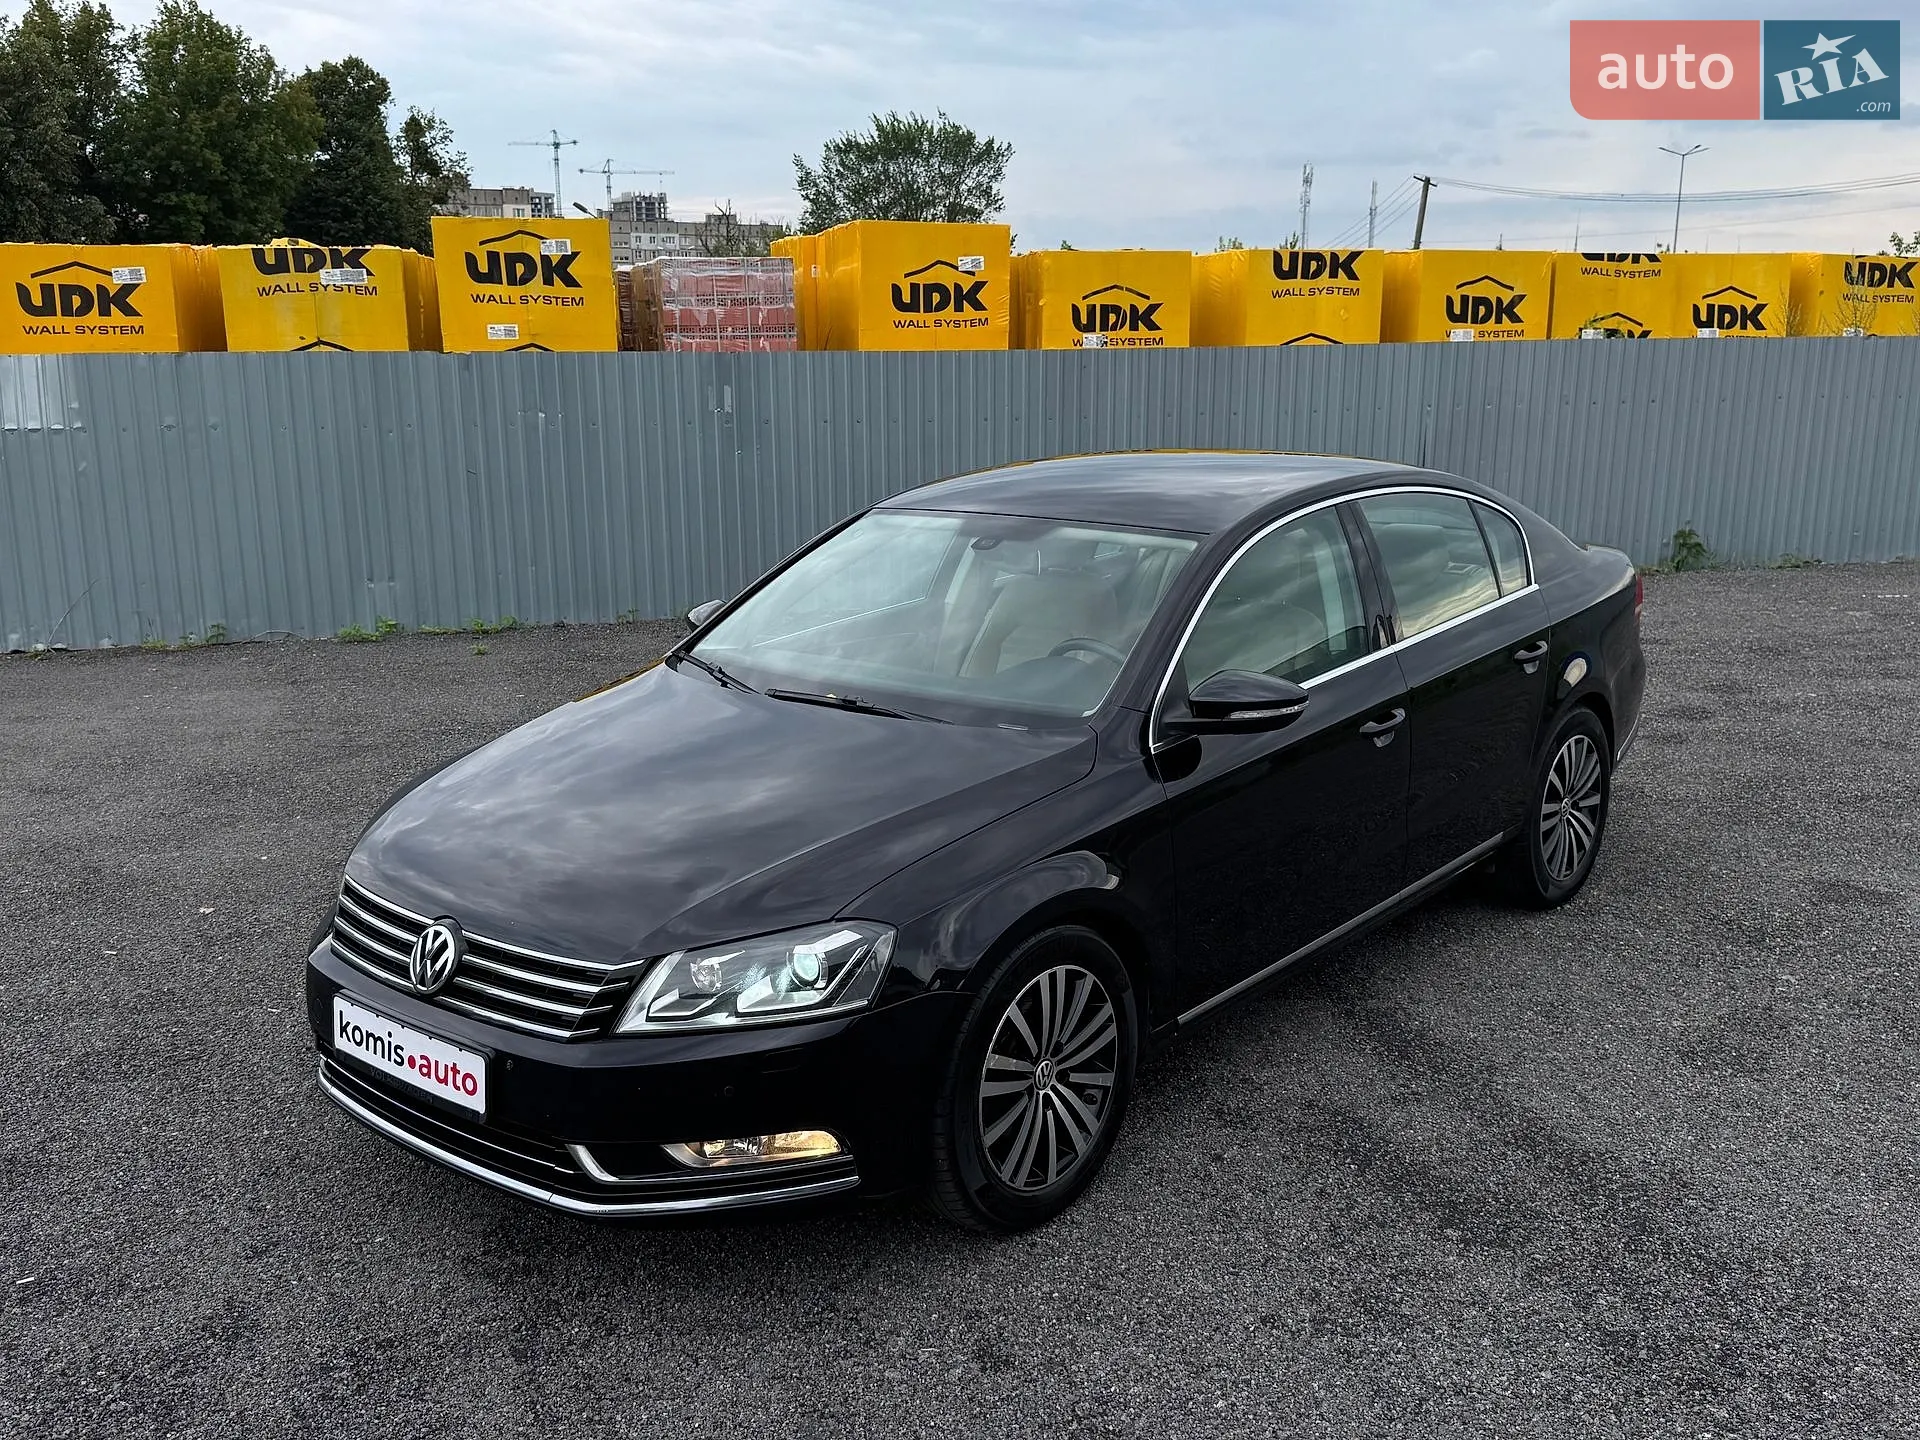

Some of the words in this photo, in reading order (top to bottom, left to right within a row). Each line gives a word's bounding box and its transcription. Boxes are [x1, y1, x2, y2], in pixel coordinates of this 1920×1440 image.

[252, 248, 375, 277] UDK
[465, 250, 583, 288] UDK
[1273, 250, 1364, 281] UDK
[1581, 267, 1611, 277] WALL
[1614, 269, 1662, 278] SYSTEM
[1844, 261, 1919, 288] UDK
[15, 282, 143, 317] UDK
[257, 282, 305, 297] WALL
[309, 282, 378, 296] SYSTEM
[470, 293, 516, 305] WALL
[519, 294, 584, 306] SYSTEM
[891, 281, 988, 313] UDK
[1272, 287, 1305, 298] WALL
[1308, 286, 1360, 297] SYSTEM
[1842, 293, 1870, 304] WALL
[1872, 294, 1915, 304] SYSTEM
[1071, 303, 1164, 333] UDK
[1446, 294, 1527, 324] UDK
[1692, 303, 1769, 330] UDK
[22, 325, 70, 335] WALL
[75, 325, 144, 335] SYSTEM
[893, 319, 930, 329] WALL
[933, 317, 989, 328] SYSTEM
[1478, 329, 1525, 338] SYSTEM
[1109, 336, 1164, 346] SYSTEM
